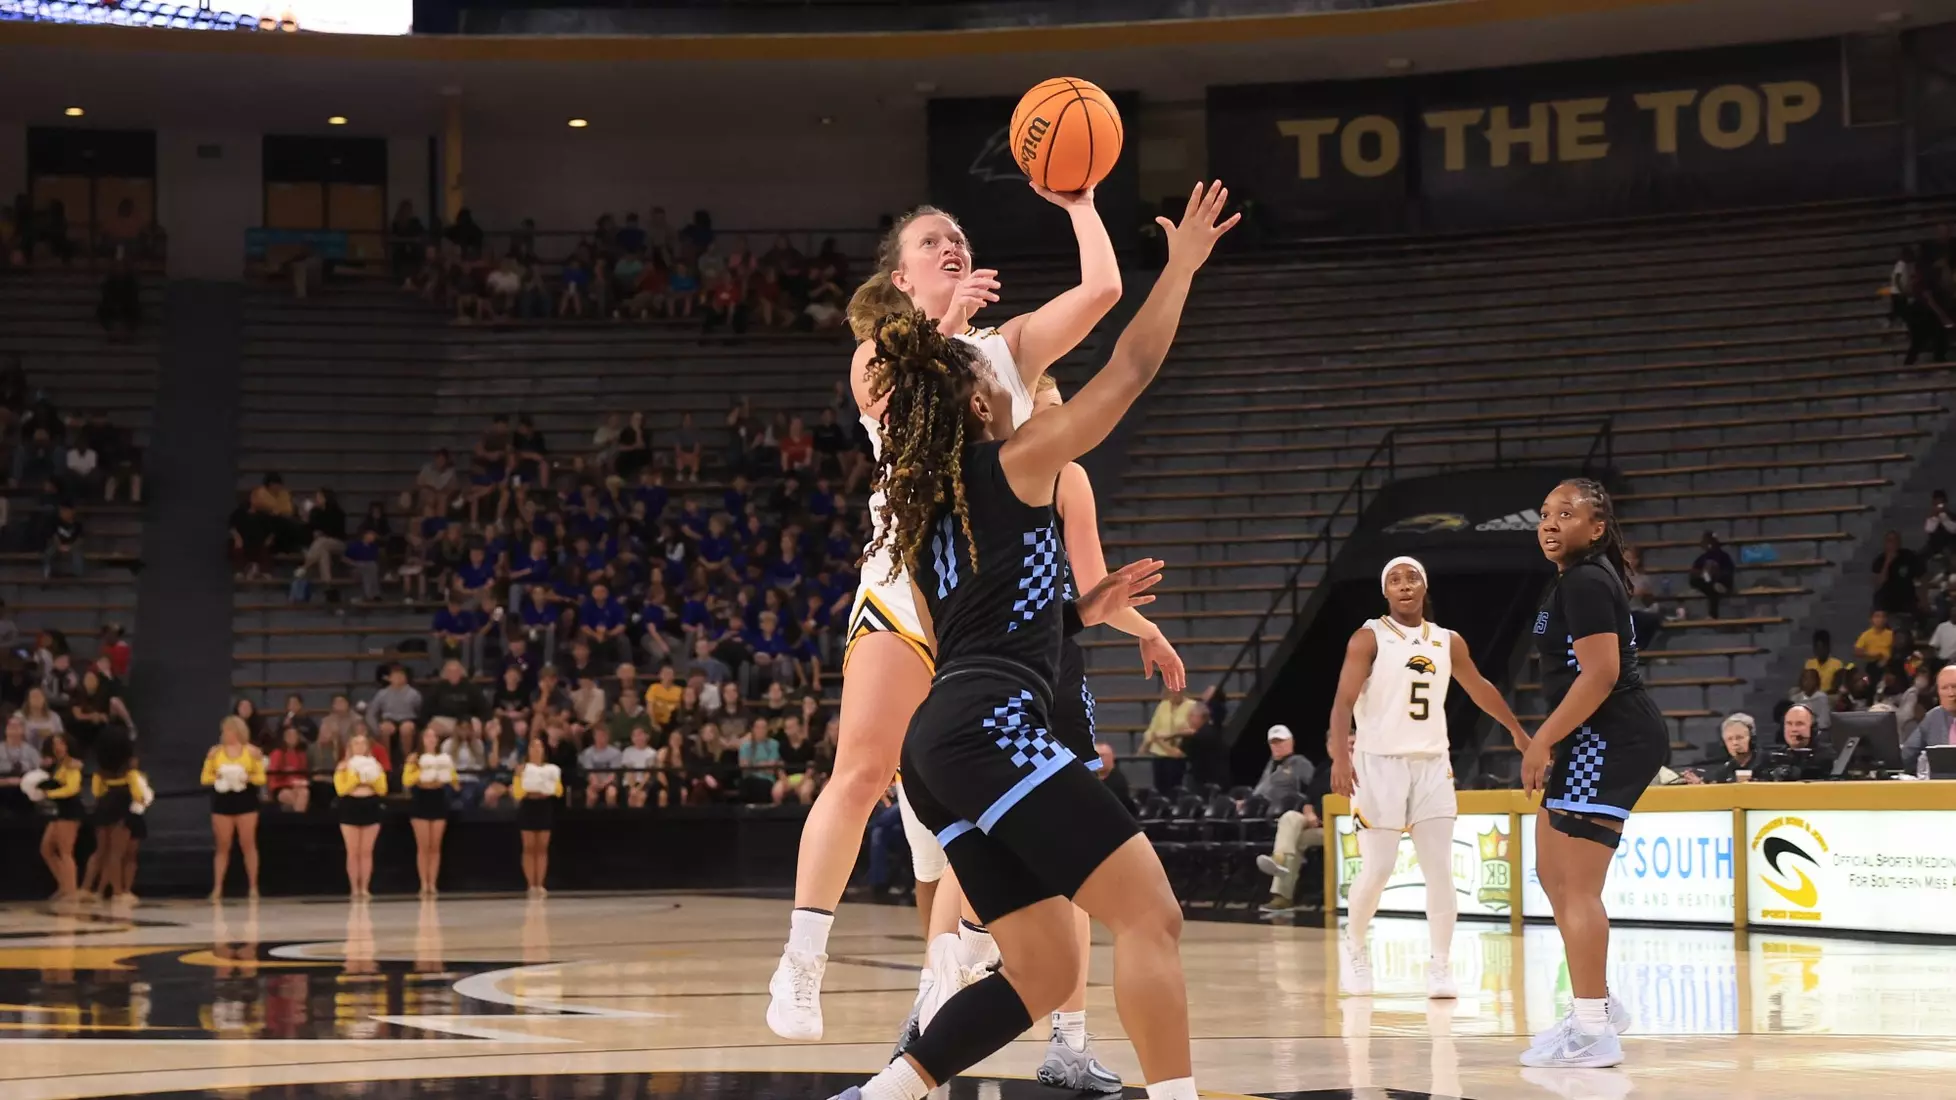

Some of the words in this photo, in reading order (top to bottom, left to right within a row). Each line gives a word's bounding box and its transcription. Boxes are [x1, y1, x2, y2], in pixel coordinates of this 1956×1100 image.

[1020, 116, 1051, 181] Wilso
[1277, 115, 1400, 179] TO
[1423, 97, 1611, 170] THE
[1633, 81, 1822, 153] TOP
[1409, 682, 1430, 720] 5
[1614, 836, 1734, 879] RSOUTH
[1916, 855, 1956, 869] MEDICIN
